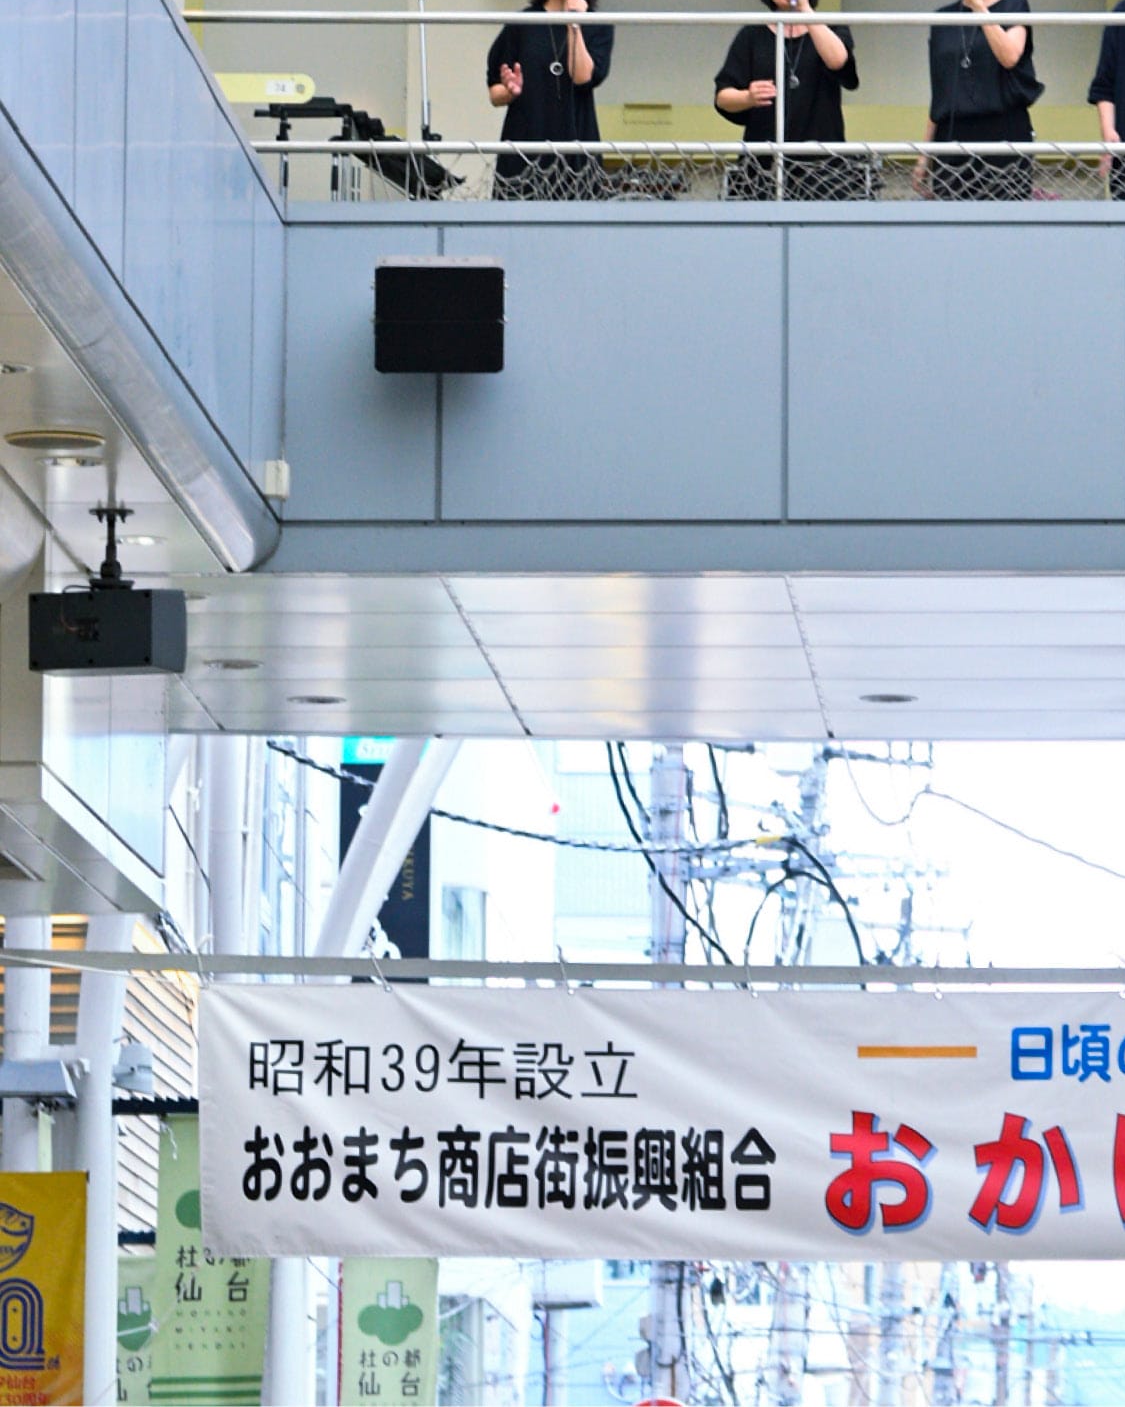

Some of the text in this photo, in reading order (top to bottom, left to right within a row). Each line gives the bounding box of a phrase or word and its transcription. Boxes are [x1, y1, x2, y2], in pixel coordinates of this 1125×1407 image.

[247, 1038, 639, 1100] 昭和39年設立
[242, 1124, 776, 1212] おおまち商店街振興組合
[174, 1271, 249, 1303] 仙台
[358, 1371, 420, 1397] 仙台
